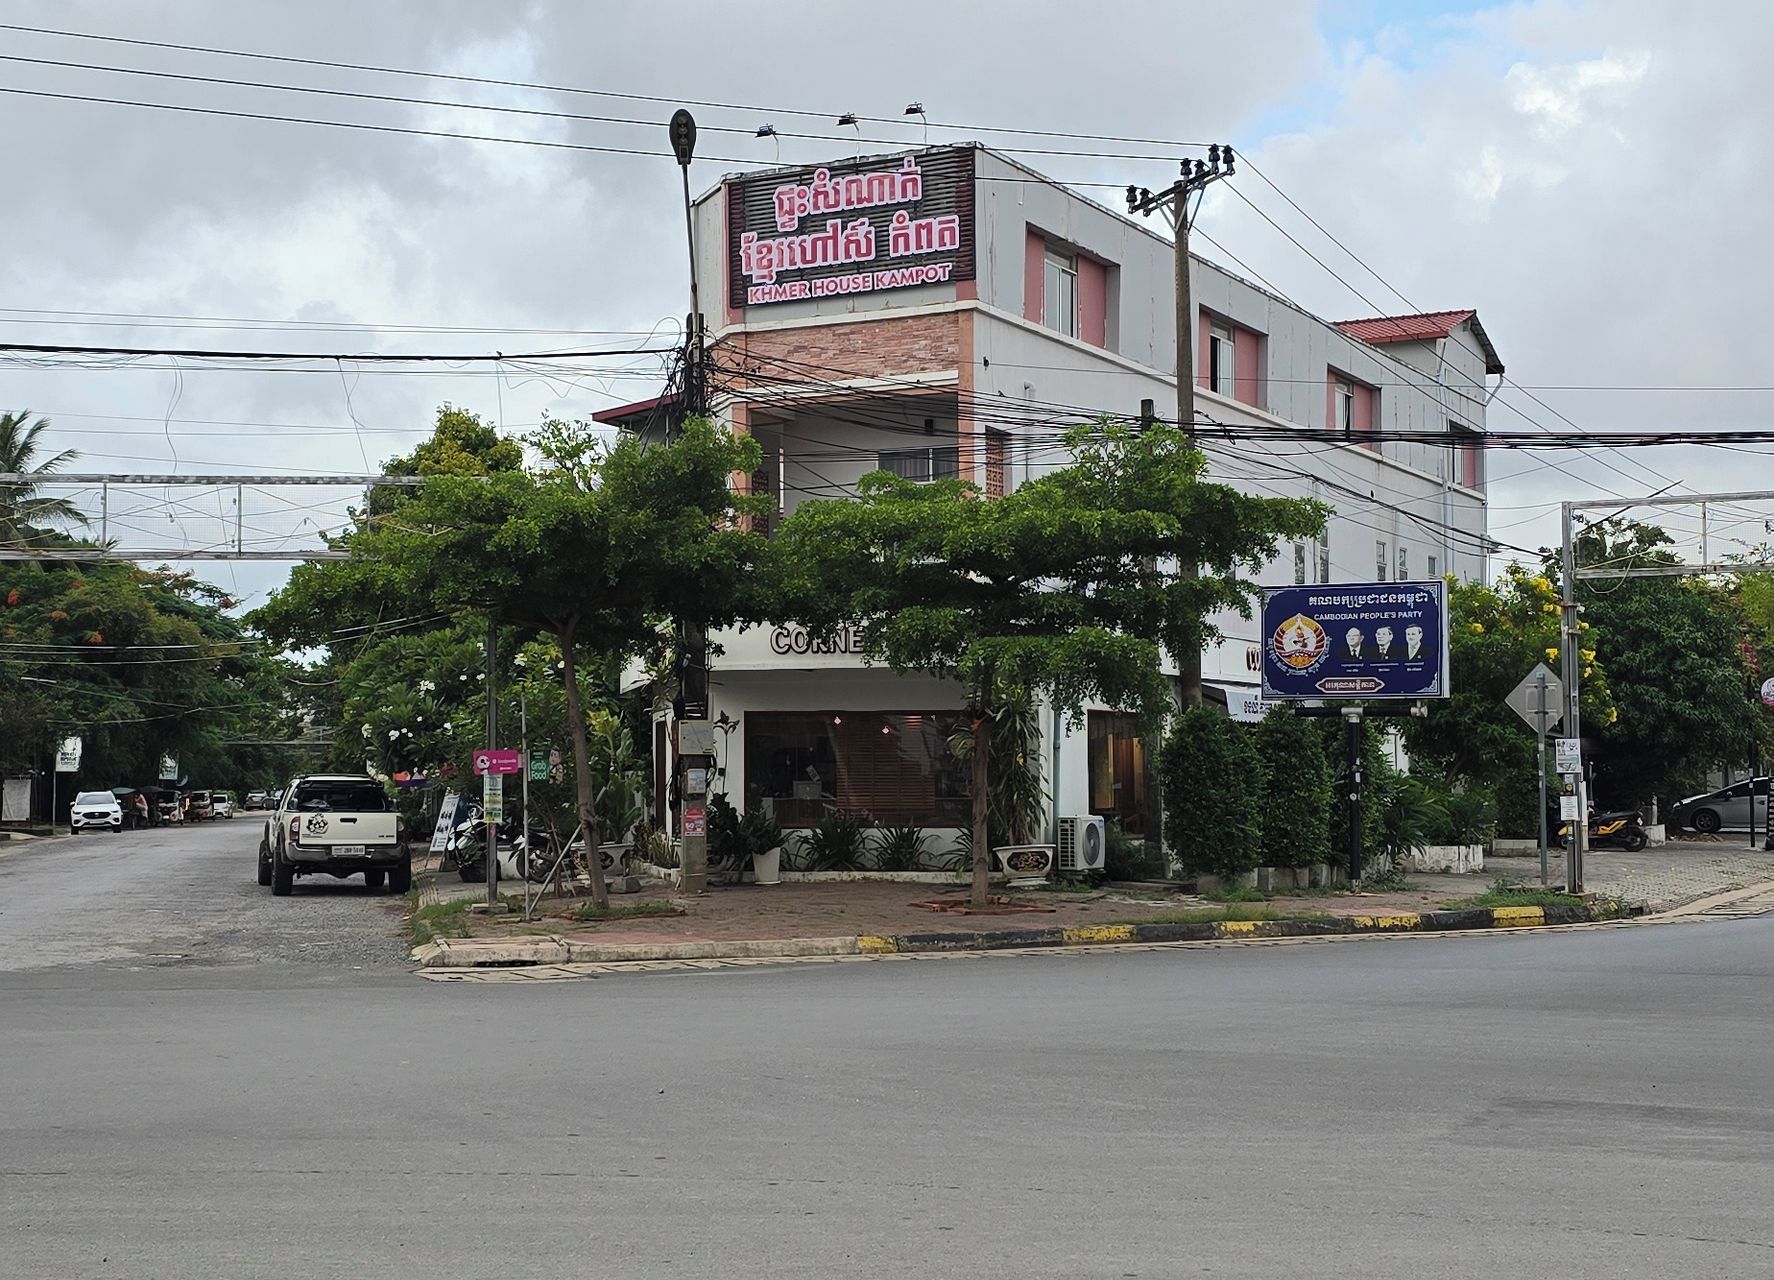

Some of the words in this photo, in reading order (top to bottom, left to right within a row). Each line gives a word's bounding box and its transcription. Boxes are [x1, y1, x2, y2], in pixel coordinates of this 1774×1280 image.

[774, 157, 922, 231] ផ្ទះសំណាក់
[890, 211, 959, 256] កំពត
[749, 281, 811, 303] KHMER
[813, 274, 871, 296] HOUSE
[875, 264, 952, 289] KAMPOT
[1314, 613, 1358, 621] CAMBODIAN
[1360, 611, 1396, 620] PEOPLE'S
[1398, 610, 1423, 619] PARTY
[531, 760, 547, 770] Grab
[531, 770, 547, 780] Food
